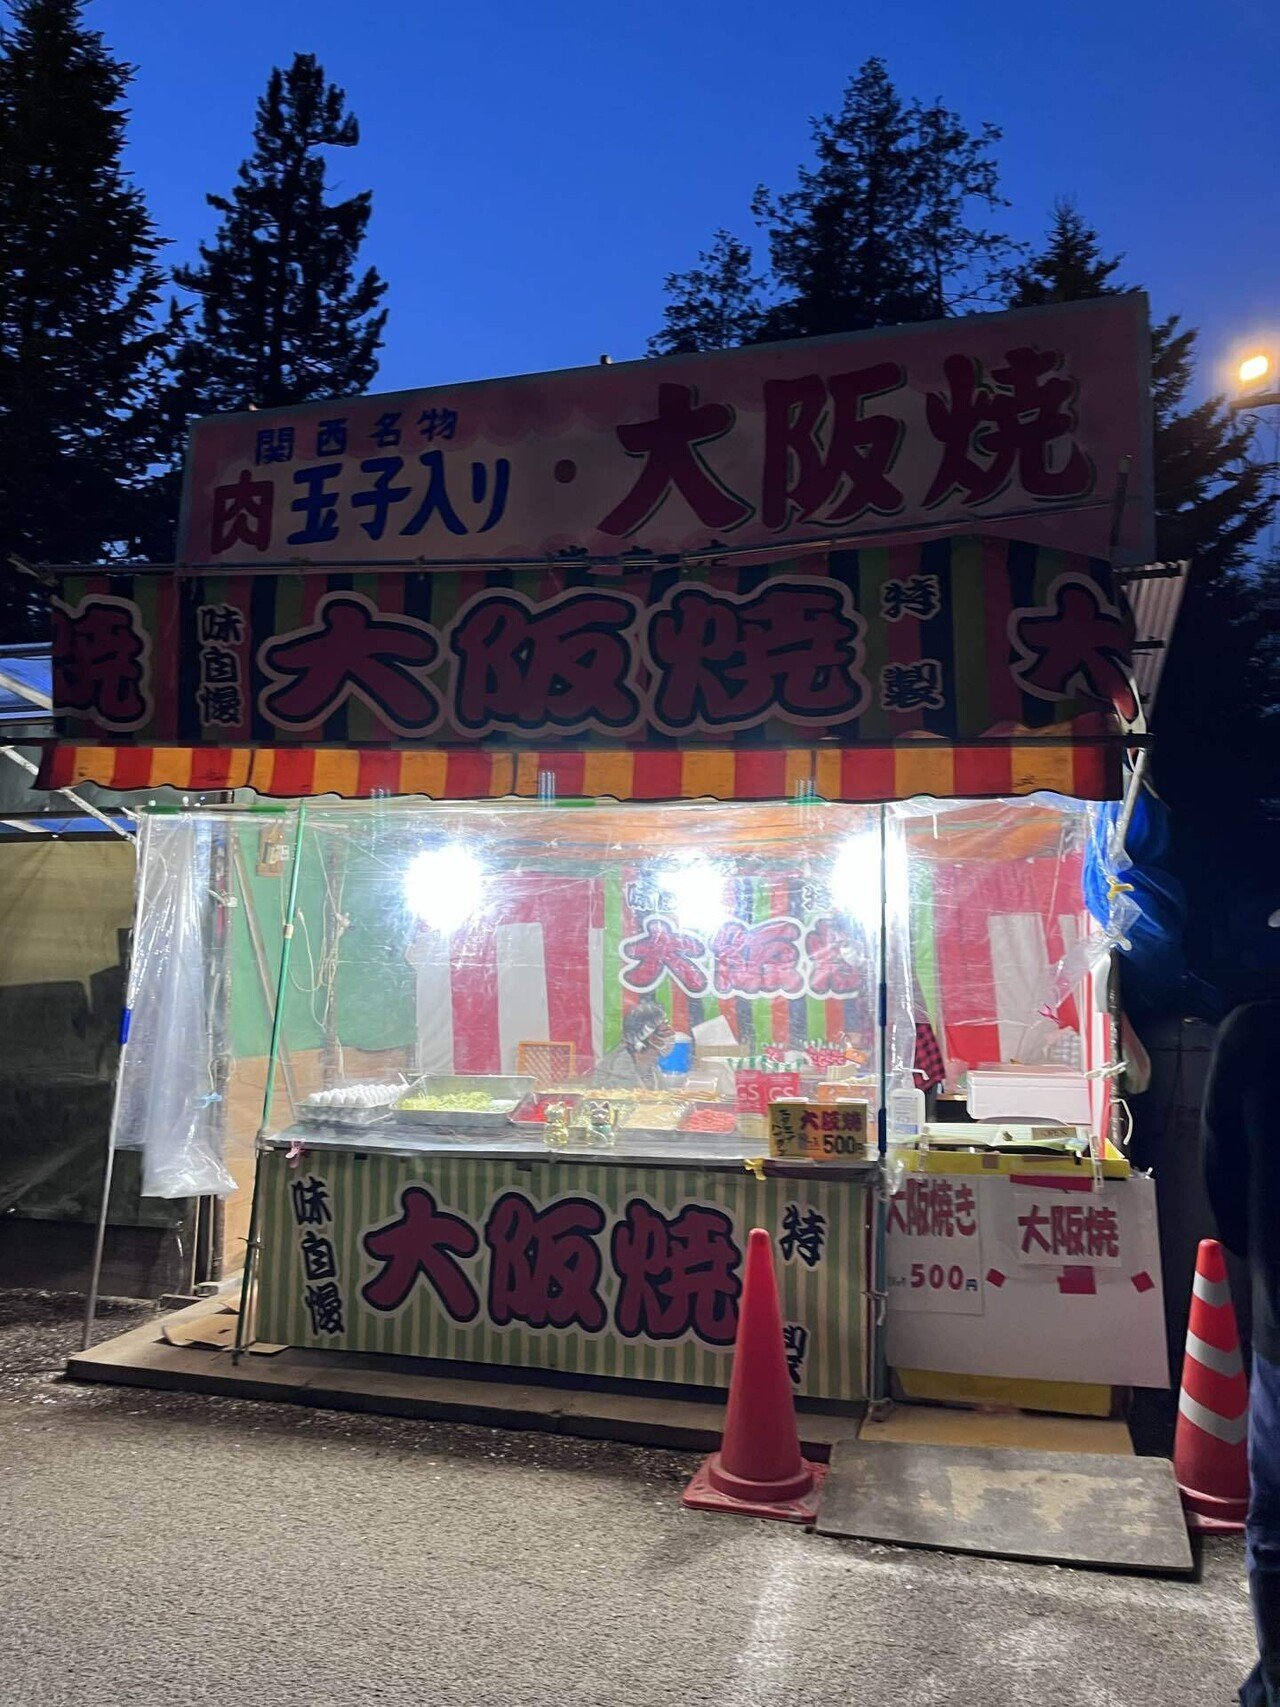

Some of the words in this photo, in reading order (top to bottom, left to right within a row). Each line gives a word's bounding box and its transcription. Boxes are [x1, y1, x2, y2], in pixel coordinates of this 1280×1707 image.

[256, 407, 459, 466] 関西名物
[598, 346, 1096, 537] 大阪焼
[210, 449, 511, 555] 肉玉子入り
[197, 604, 246, 728] 味自慢
[259, 575, 869, 738] 大阪焼
[881, 574, 945, 711] 特製
[292, 1175, 344, 1336] 味自慢
[363, 1186, 742, 1345] 大阪焼
[886, 1178, 977, 1238] 大阪焼き
[1017, 1204, 1120, 1258] 大阪焼
[910, 1263, 979, 1292] 500円
